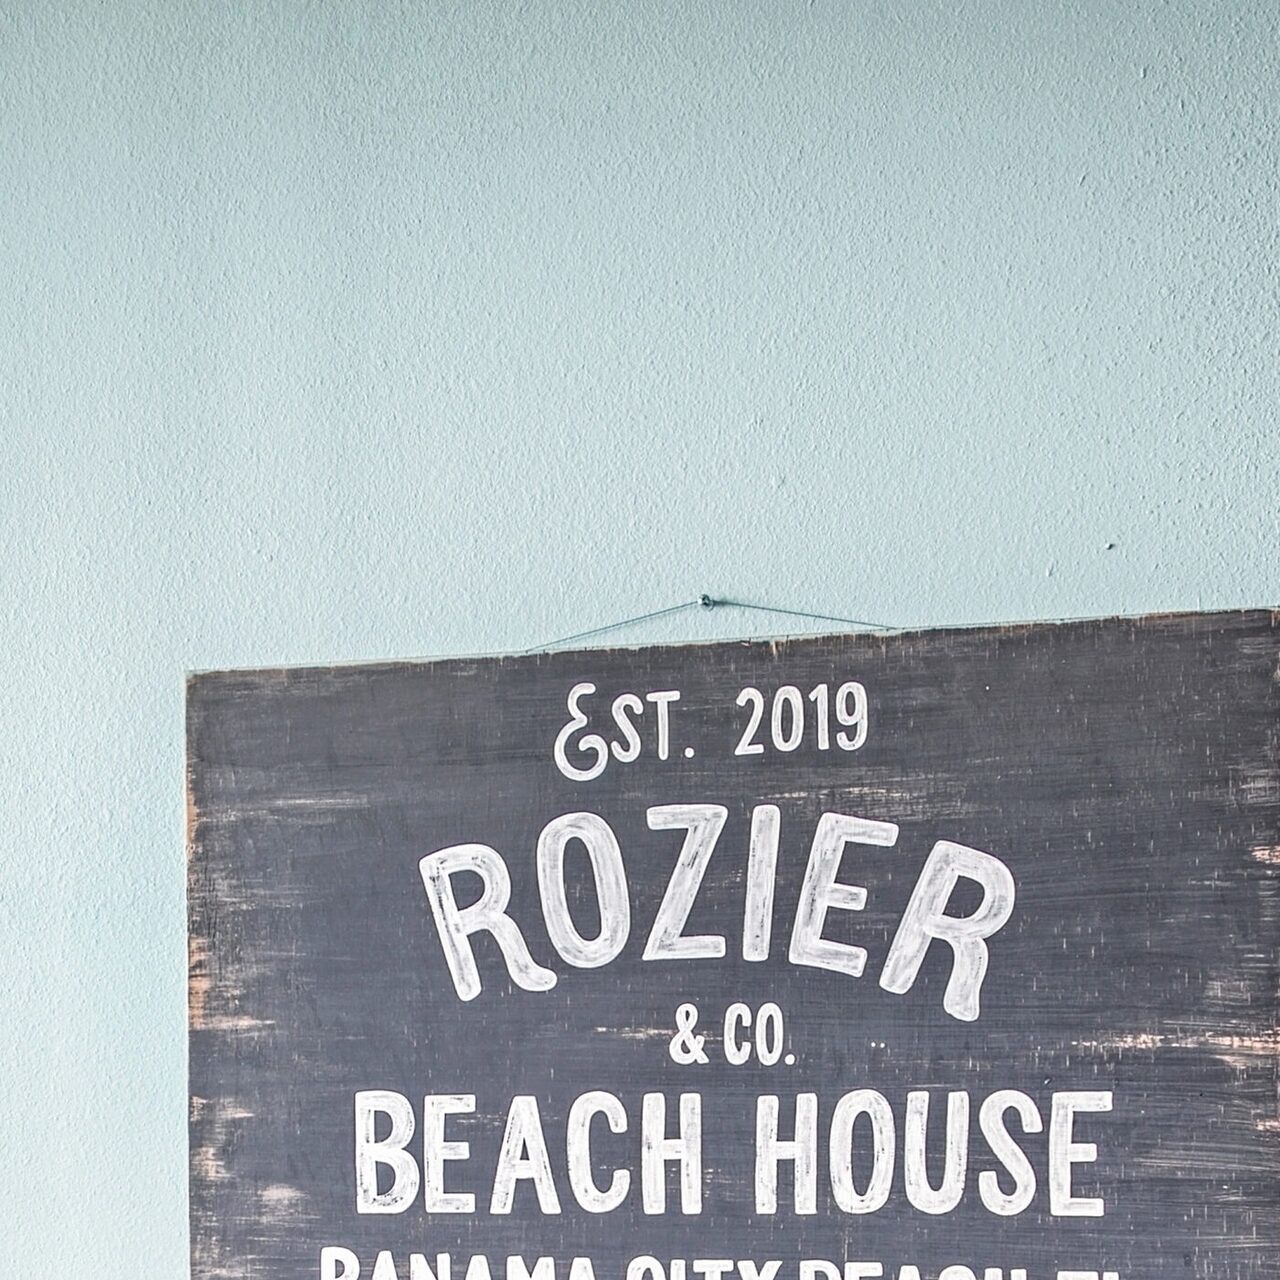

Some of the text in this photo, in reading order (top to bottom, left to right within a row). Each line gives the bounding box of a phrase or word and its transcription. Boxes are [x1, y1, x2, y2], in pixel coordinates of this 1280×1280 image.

[735, 681, 868, 756] 2019
[418, 803, 1016, 1022] ROZIER
[668, 1002, 796, 1066] & CO.
[354, 1089, 1113, 1217] BEACH HOUSE
